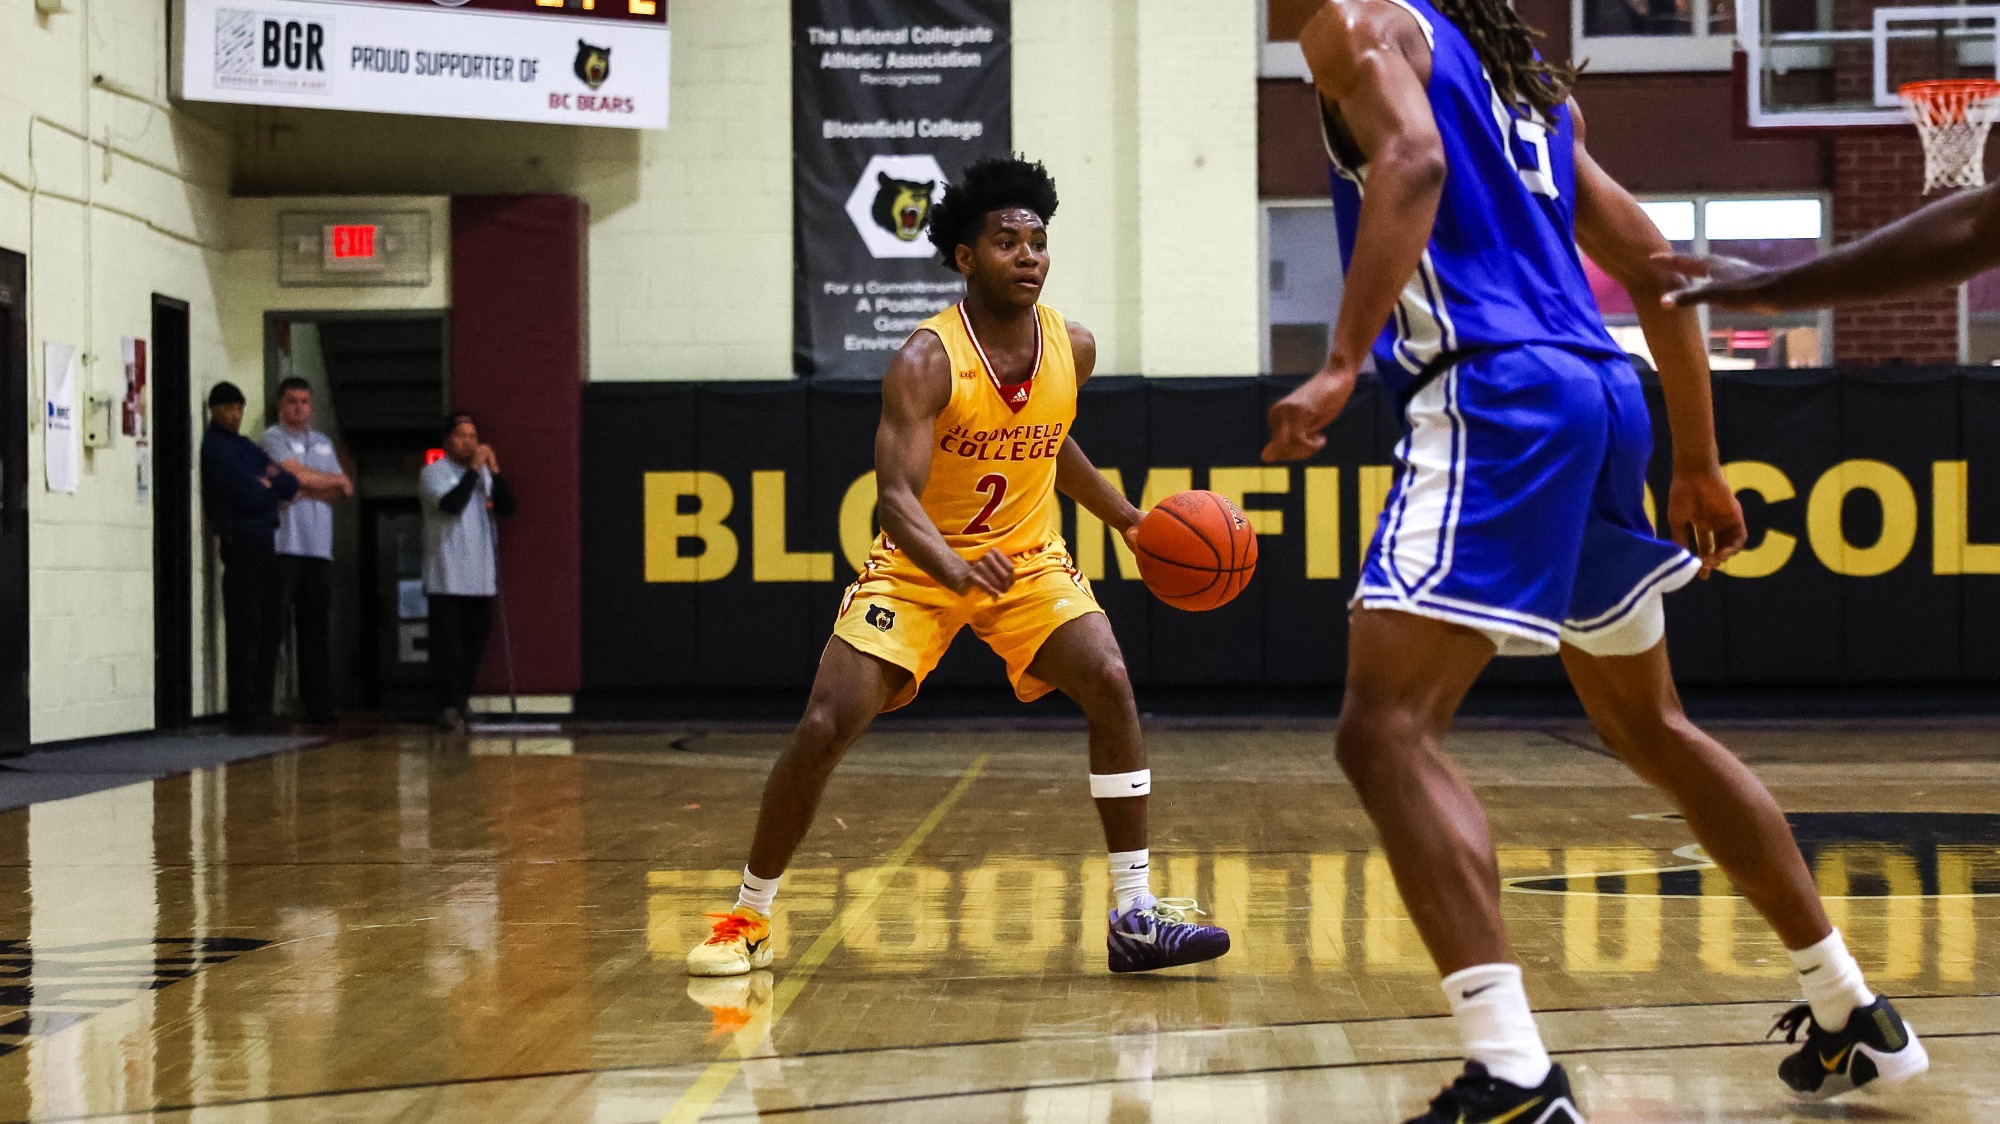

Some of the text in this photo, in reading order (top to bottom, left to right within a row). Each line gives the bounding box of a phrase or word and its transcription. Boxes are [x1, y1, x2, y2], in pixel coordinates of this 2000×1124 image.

[263, 20, 324, 71] BGR
[808, 26, 994, 46] The National Collegiate
[352, 45, 540, 83] PROUD SUPPORTER OF
[821, 52, 981, 69] Athletic Association
[548, 93, 634, 114] BC BEARS
[823, 118, 983, 140] Bloomfield College
[823, 282, 849, 295] For
[844, 334, 908, 351] Enviro
[948, 422, 1063, 442] BLOOMFIELD
[939, 438, 1060, 461] COLLEGE
[961, 473, 1009, 535] 2
